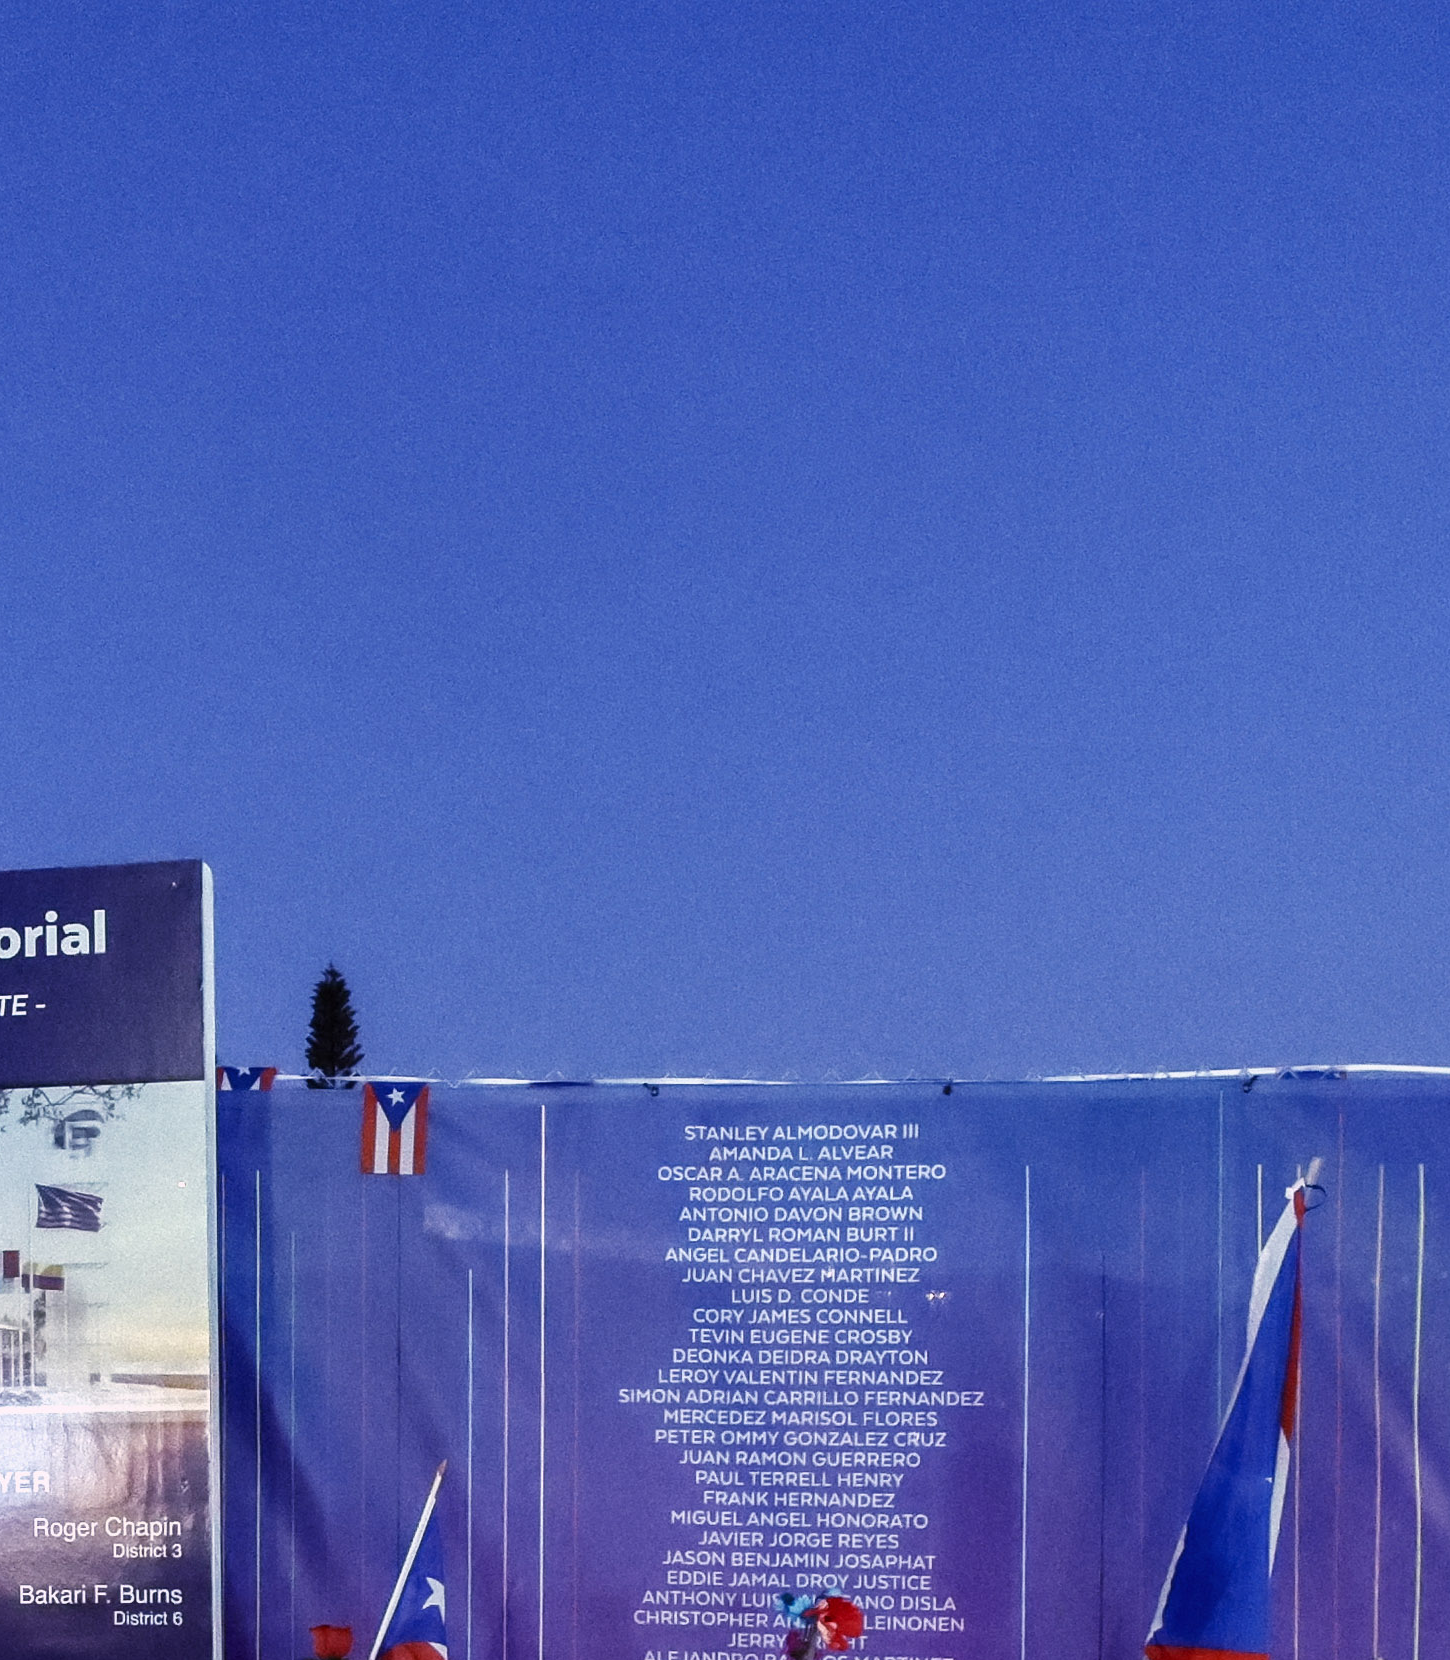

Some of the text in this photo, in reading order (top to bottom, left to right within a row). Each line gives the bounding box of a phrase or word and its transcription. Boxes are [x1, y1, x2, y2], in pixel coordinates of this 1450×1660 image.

[685, 1124, 918, 1140] STANLEY ALMODOVAR III
[710, 1145, 893, 1161] AMANDA L. ALVEAR
[658, 1166, 722, 1181] OSCAR
[750, 1166, 841, 1181] ARACENA
[848, 1165, 946, 1180] MONTERO
[690, 1186, 913, 1202] RODOLFO AYALA AYALA
[680, 1207, 922, 1222] ANTONIO DAVON BROWN
[689, 1228, 763, 1242] DARRYL
[769, 1228, 840, 1242] ROMAN
[847, 1227, 898, 1242] BURT
[666, 1247, 937, 1262] ANGEL CANDELARIO-PADRO
[683, 1267, 919, 1283] JUAN CHAVEZ MARTINEZ
[732, 1289, 868, 1303] LUIS D. CONDE
[693, 1309, 907, 1323] CORY JAMES CONNELL
[689, 1329, 912, 1344] TEVIN EUGENE CROSBY
[673, 1349, 927, 1364] DEONKA DEIDRA DRAYTON
[659, 1369, 943, 1385] LEROY VALENTIN FERNANDEZ
[620, 1389, 983, 1405] SIMON ADRIAN CARRILLO FERNANDEZ
[34, 1517, 181, 1542] Roger Chapin
[113, 1543, 182, 1558] District 3
[20, 1584, 182, 1604] Bakari F. Burns
[114, 1611, 182, 1625] District 6
